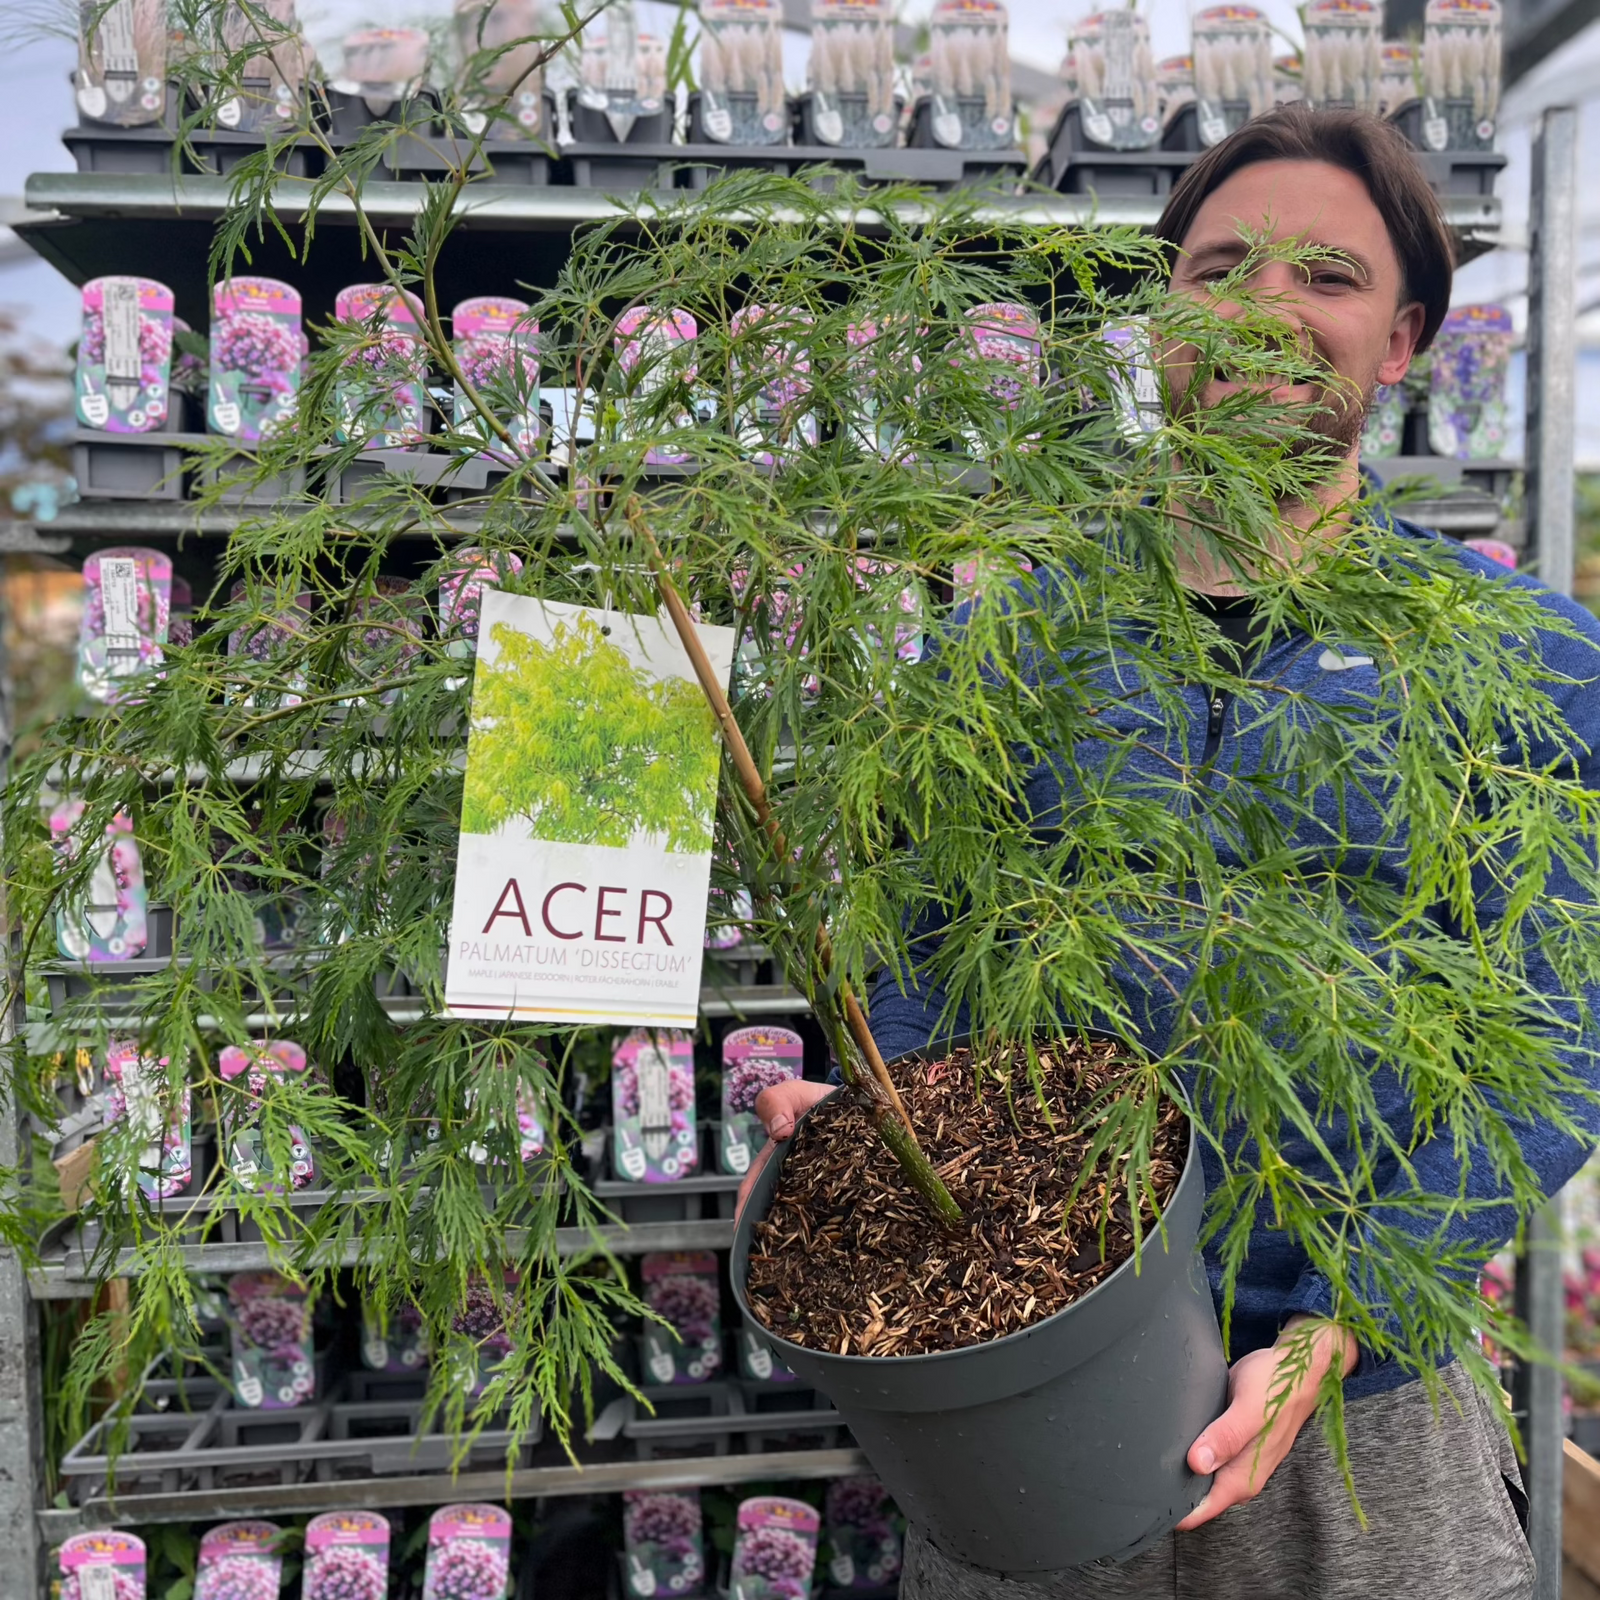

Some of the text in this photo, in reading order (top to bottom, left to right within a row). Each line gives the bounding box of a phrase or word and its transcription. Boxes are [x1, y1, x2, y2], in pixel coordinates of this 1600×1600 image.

[481, 877, 675, 947] ACER
[460, 941, 692, 973] PALMATUM 'DISSECTUM'
[468, 969, 493, 978] MAPLE
[498, 970, 533, 981] JAPANESE
[533, 972, 570, 983] ESDOORN
